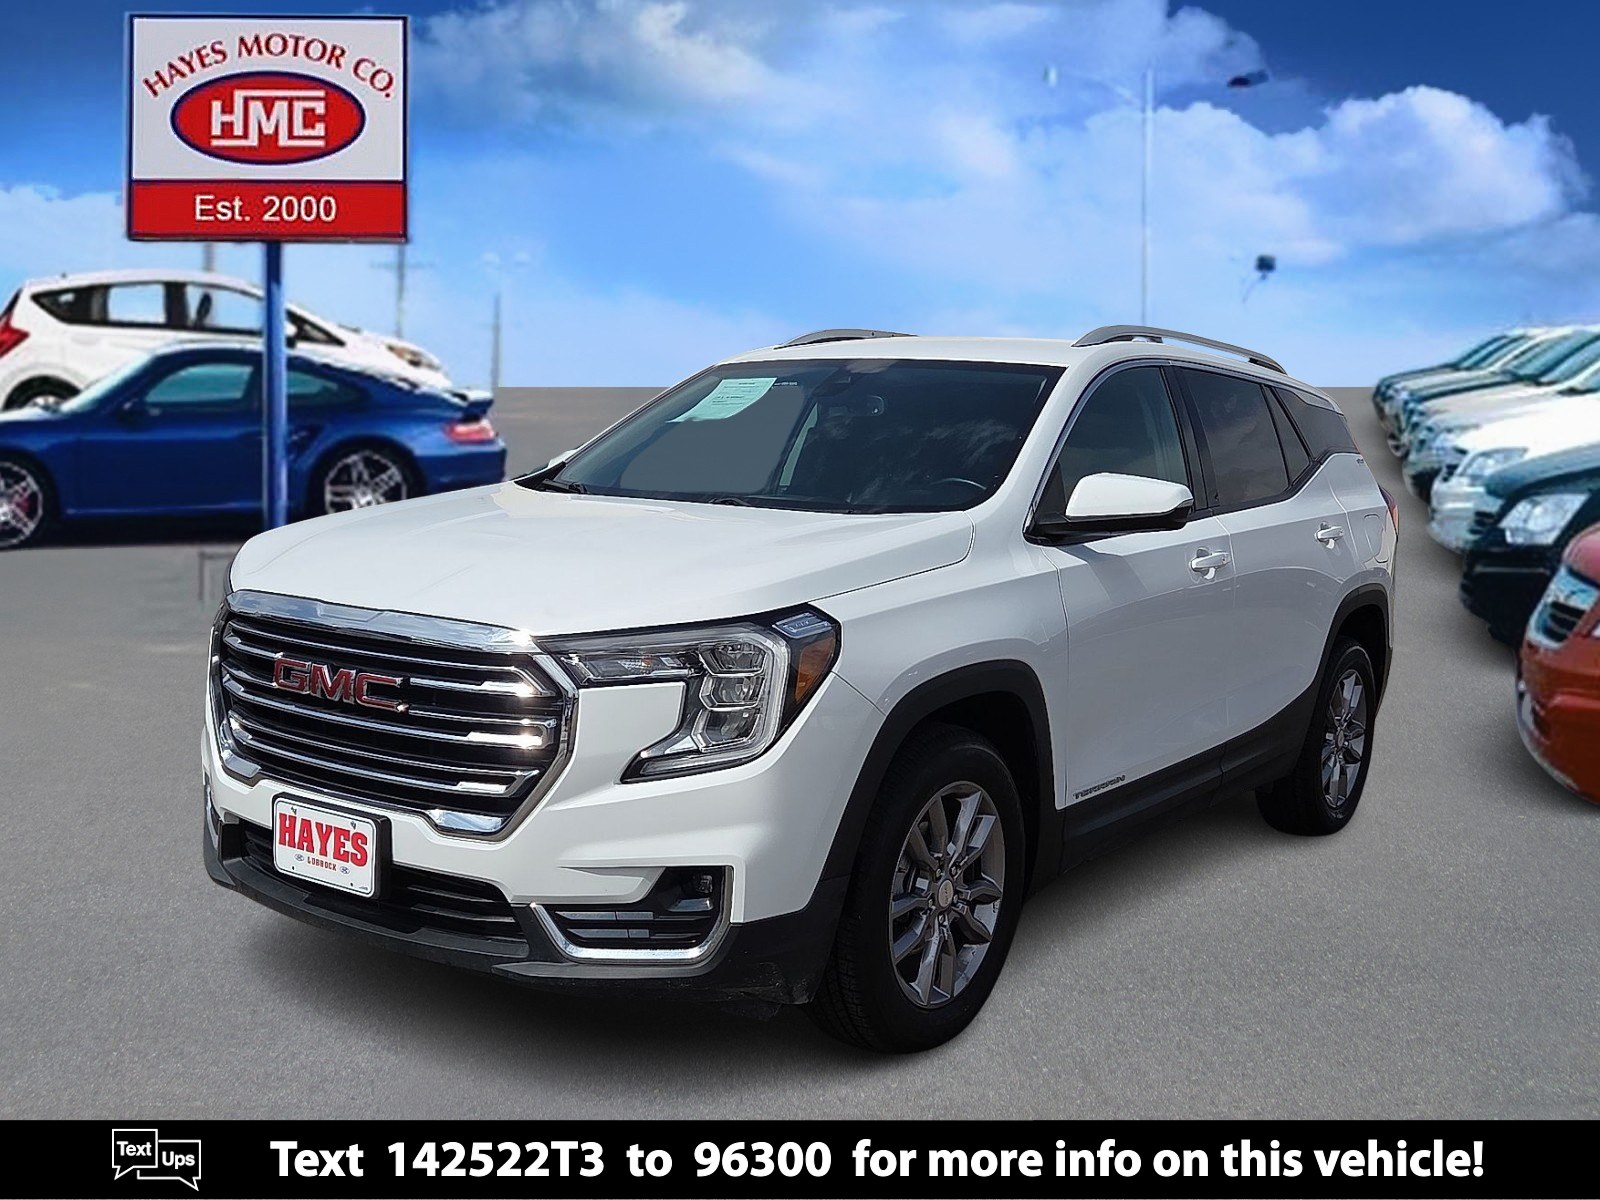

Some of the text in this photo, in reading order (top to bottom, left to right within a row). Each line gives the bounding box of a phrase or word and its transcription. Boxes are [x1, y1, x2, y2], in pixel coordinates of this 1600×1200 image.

[143, 33, 395, 98] HAYES MOTOR CO.
[210, 89, 326, 147] HMC
[194, 194, 337, 222] Est. 2000
[273, 656, 405, 712] GMC
[278, 812, 369, 868] HAYES
